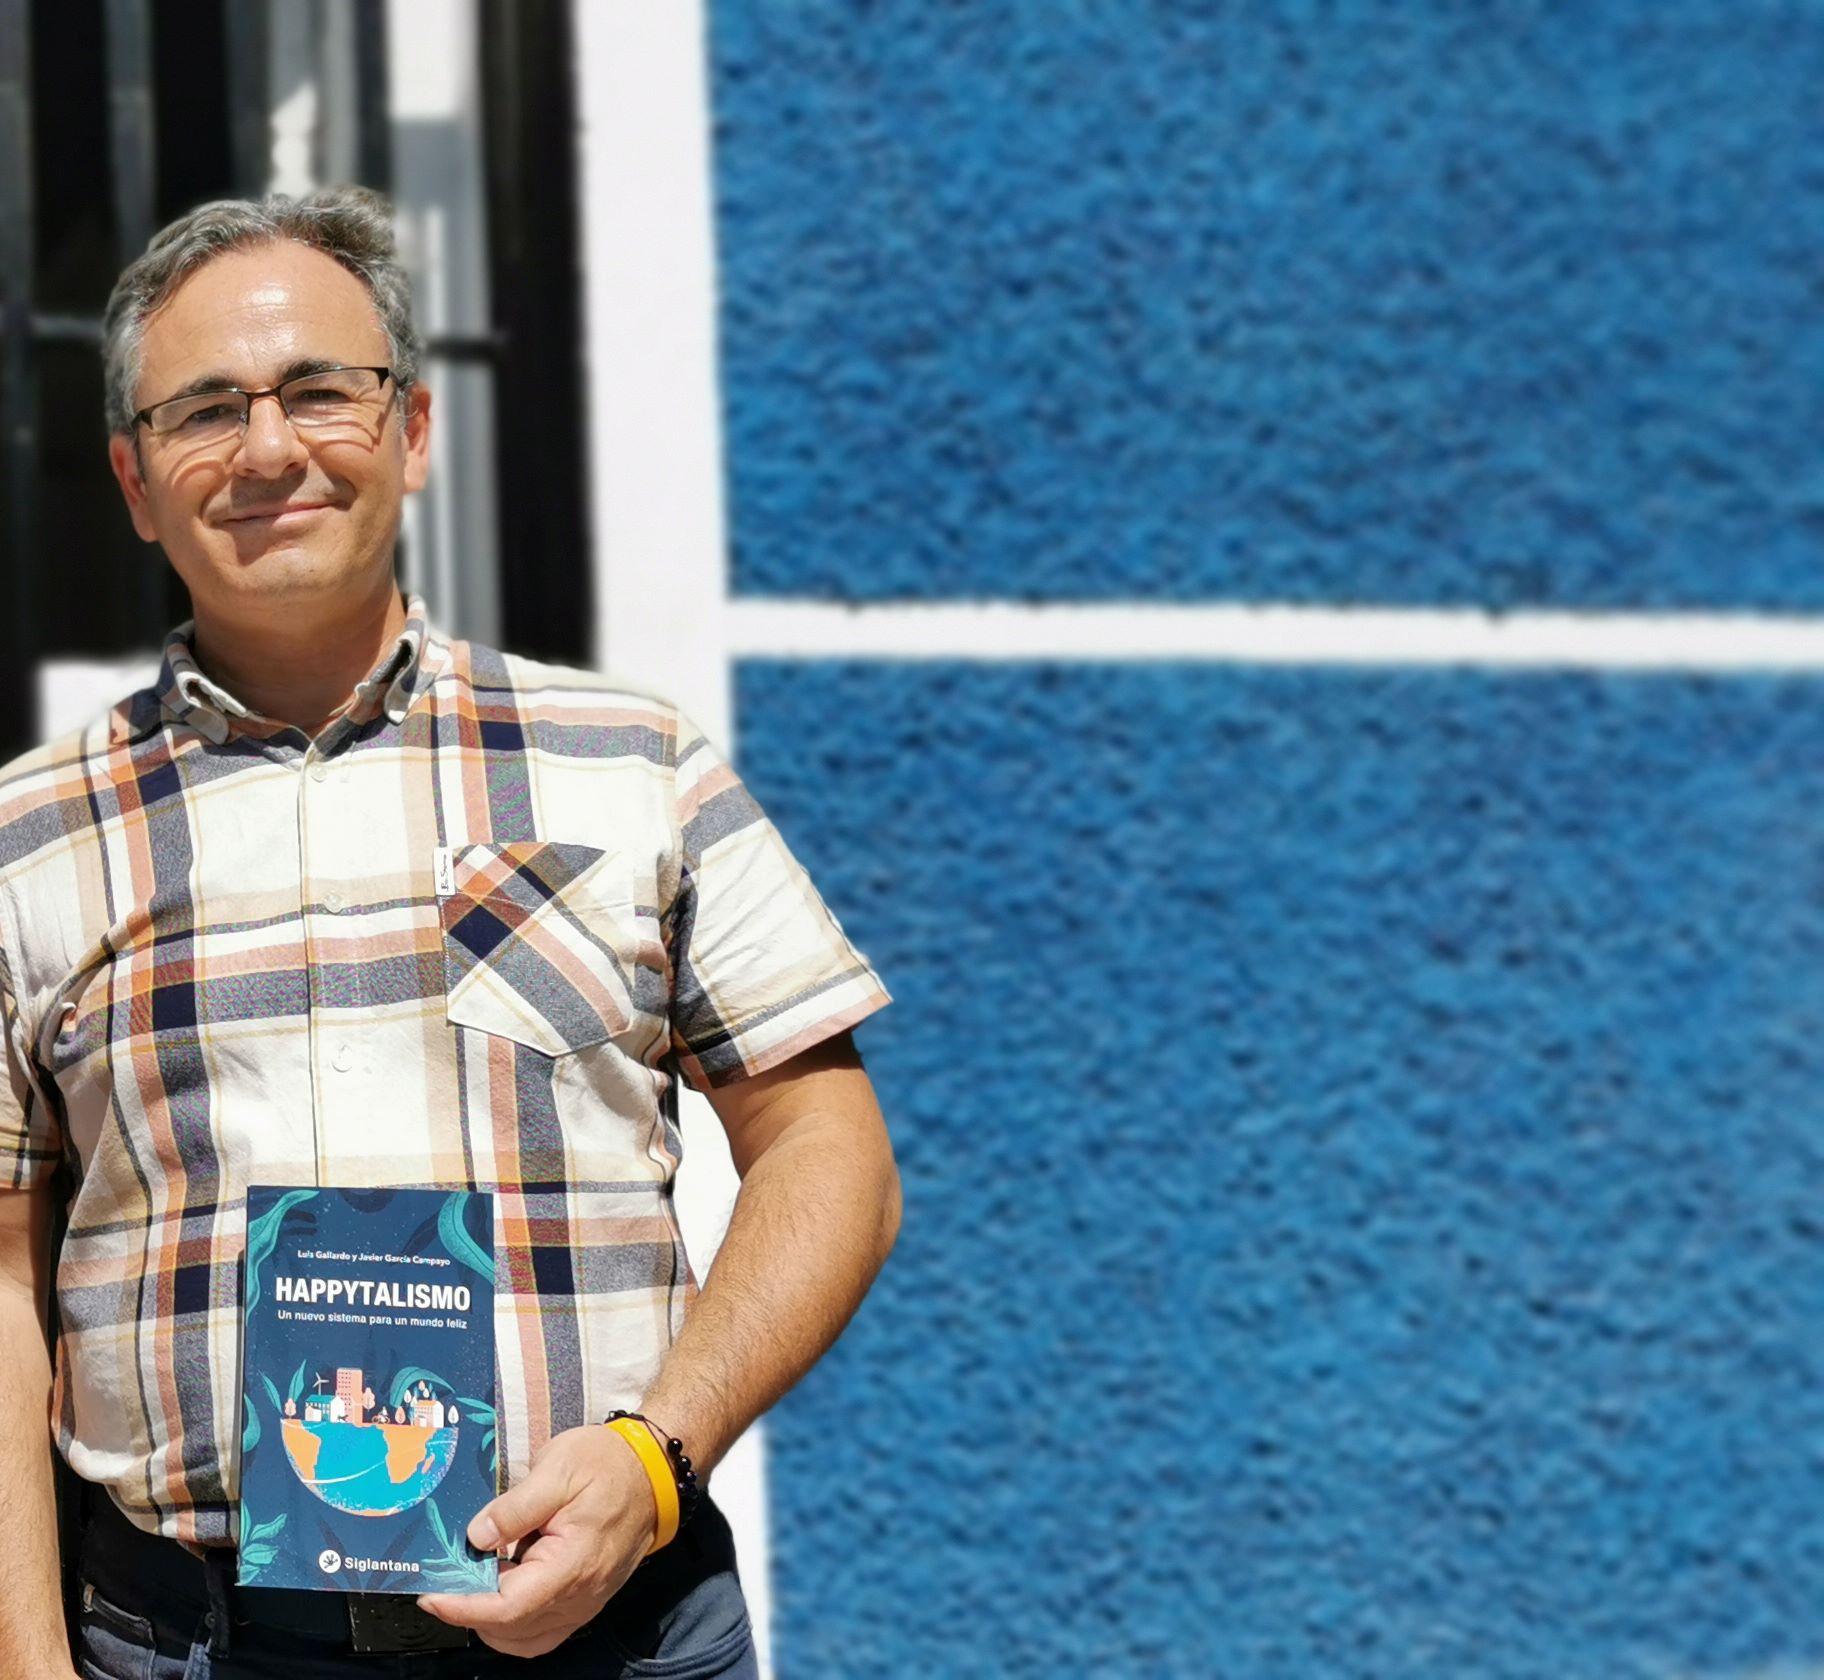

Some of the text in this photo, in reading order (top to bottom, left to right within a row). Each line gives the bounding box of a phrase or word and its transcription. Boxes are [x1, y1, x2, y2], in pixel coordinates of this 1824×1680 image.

[297, 1249, 451, 1267] Luis Gallardo y Javier García Campayo
[275, 1276, 471, 1312] HAPPYTALISMO
[277, 1309, 468, 1330] Un nuevo sistema para un mundo feliz
[344, 1557, 420, 1573] Siglantana
